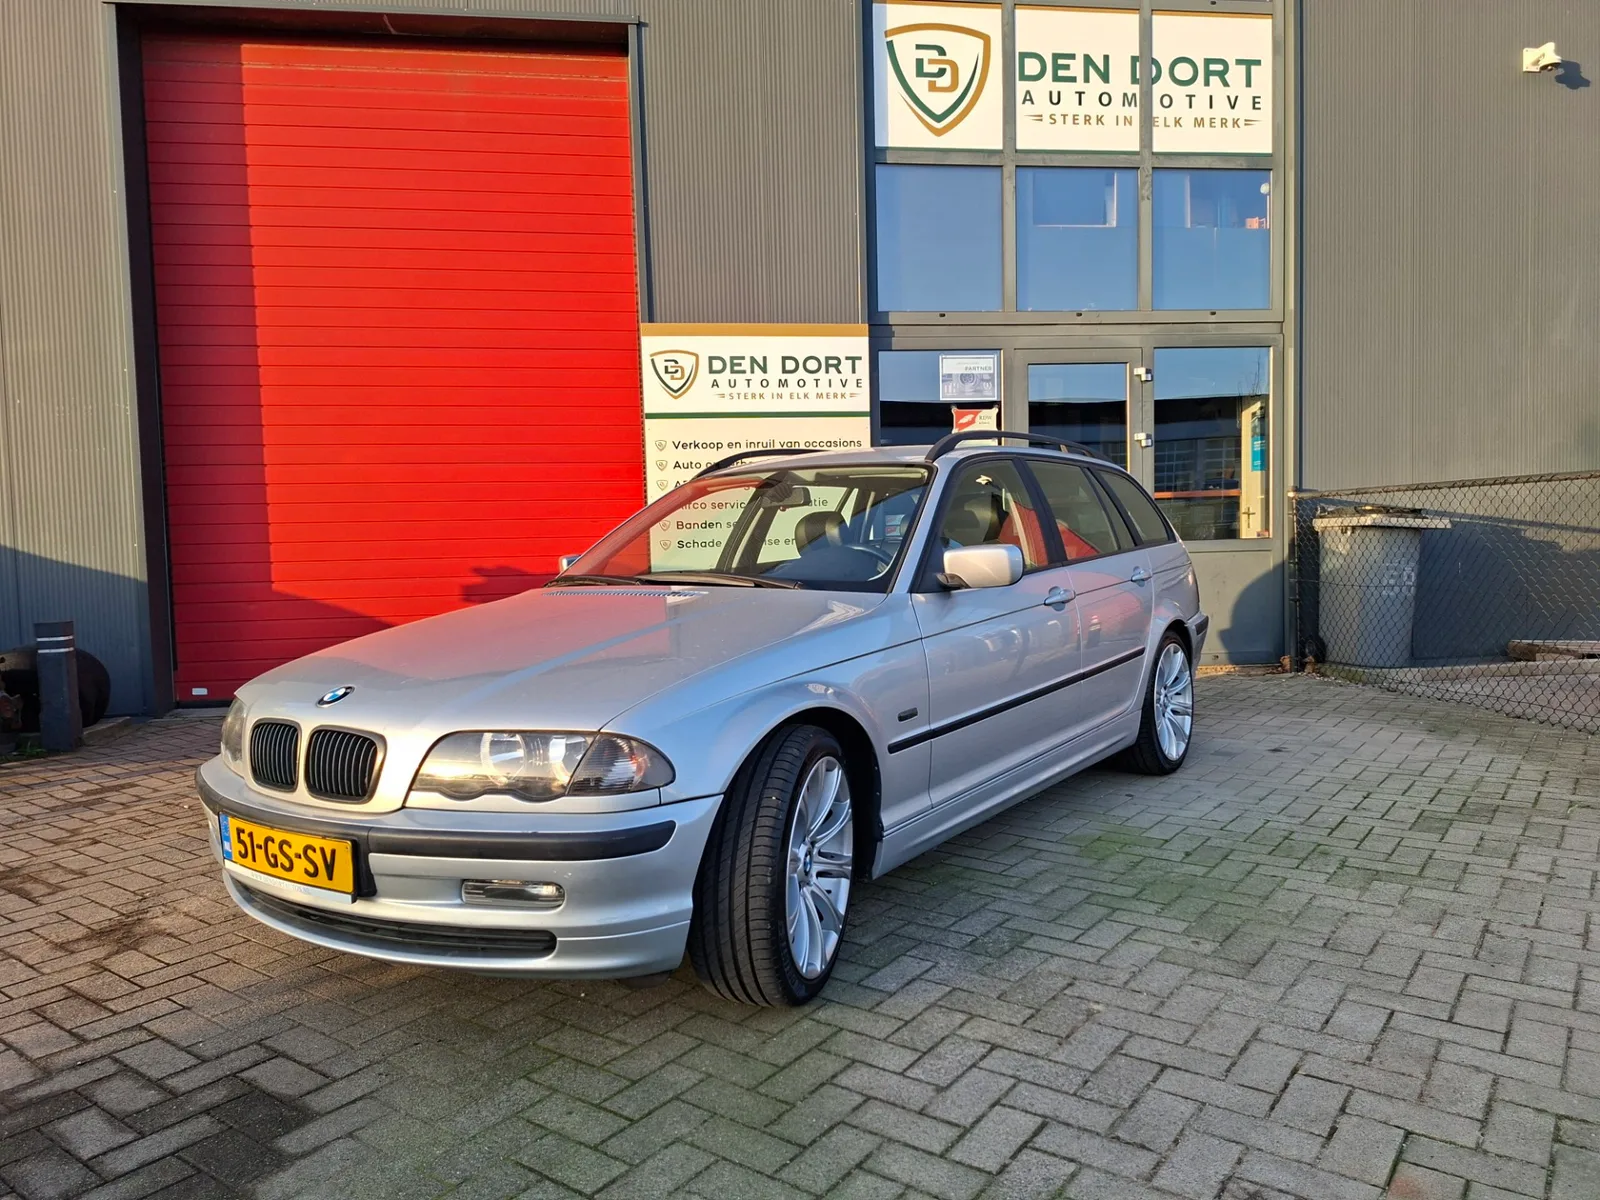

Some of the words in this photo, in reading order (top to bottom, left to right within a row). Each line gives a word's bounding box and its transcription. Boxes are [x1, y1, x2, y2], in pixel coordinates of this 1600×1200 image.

[1018, 51, 1110, 84] DEN
[1130, 55, 1262, 88] DORT
[1021, 90, 1261, 110] AUTOMOTIVE
[1049, 113, 1105, 126] STERK
[1115, 115, 1133, 127] IN
[1152, 116, 1183, 128] ELK
[1193, 117, 1241, 128] MERK
[708, 355, 768, 374] DEN
[781, 355, 862, 374] DORT
[711, 378, 863, 388] AUTOMOTIVE
[729, 392, 765, 400] STERK
[771, 392, 783, 400] IN
[789, 392, 810, 400] ELK
[815, 392, 847, 400] MERK
[672, 440, 724, 452] Verkoop
[727, 441, 742, 449] en
[745, 439, 776, 449] inruil
[779, 440, 801, 449] van
[804, 438, 863, 449] occasions
[673, 461, 702, 470] Auto
[711, 500, 746, 510] servic
[676, 521, 723, 530] Banden
[677, 539, 722, 549] Schade
[235, 826, 337, 882] 51-GS-SV
